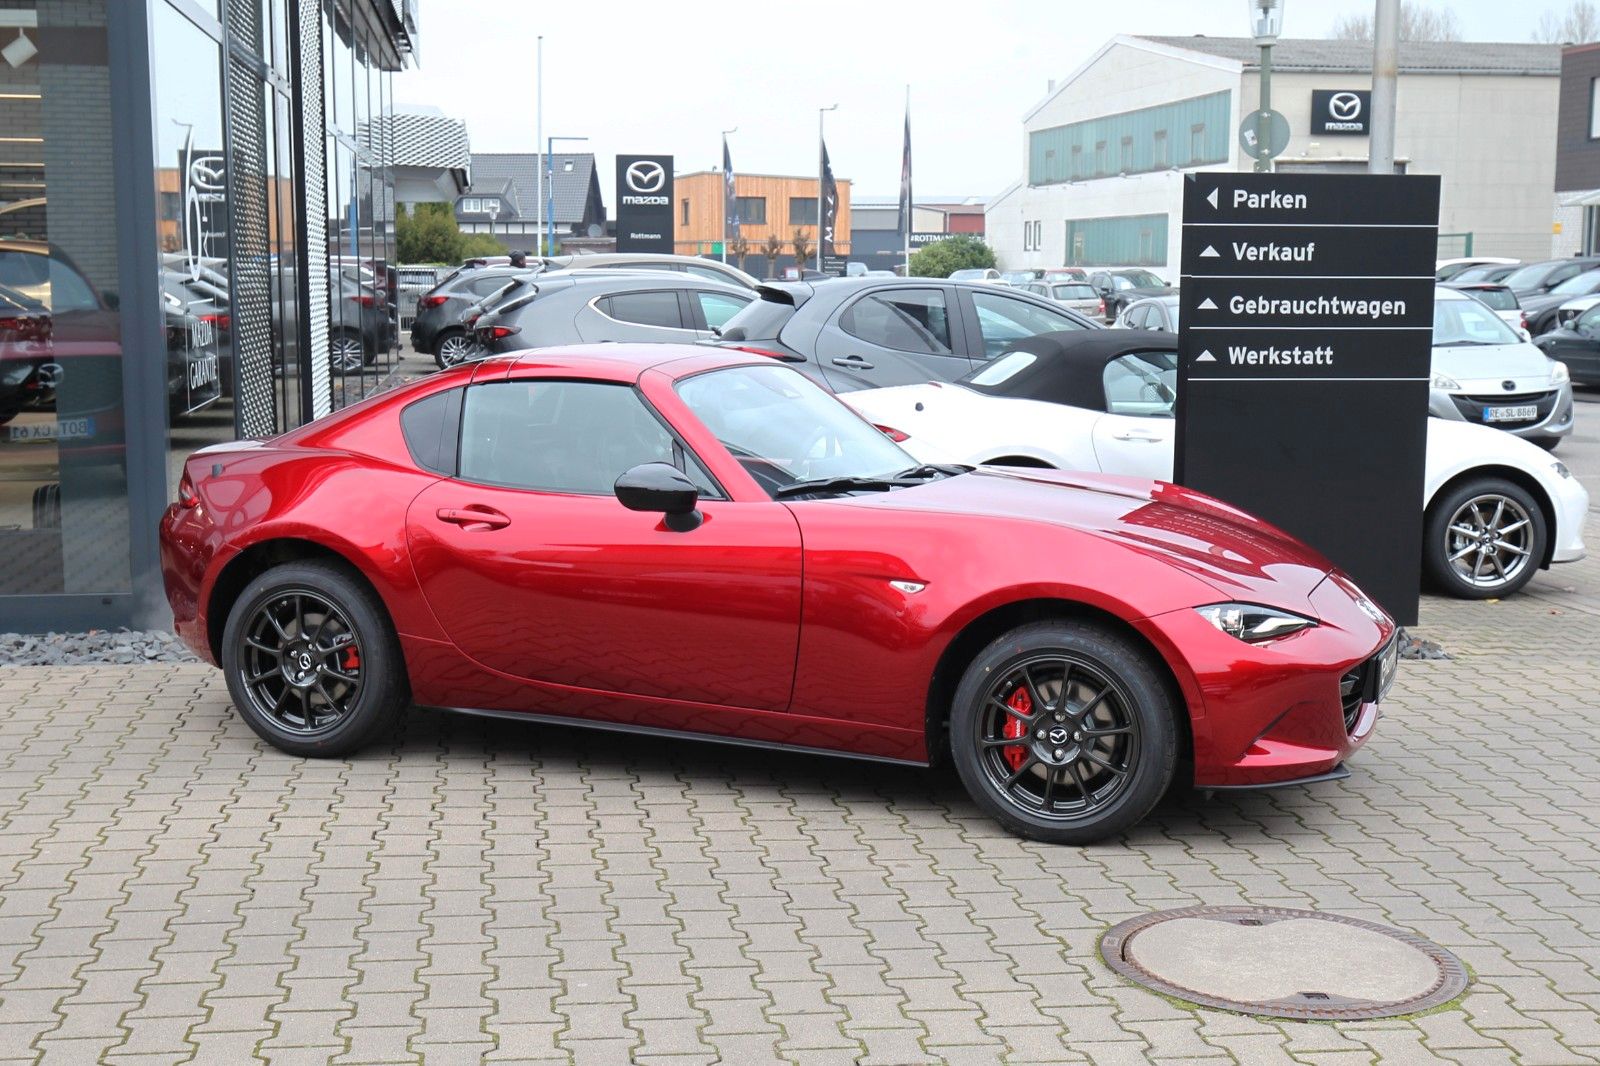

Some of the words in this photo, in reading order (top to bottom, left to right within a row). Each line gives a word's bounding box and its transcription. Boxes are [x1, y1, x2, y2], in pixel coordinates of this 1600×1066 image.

[1325, 122, 1363, 131] mazda
[622, 195, 669, 205] mazda
[1233, 189, 1307, 209] Parken
[1232, 242, 1315, 261] Verkauf
[1229, 295, 1406, 319] Gebrauchtwagen
[1228, 346, 1334, 365] Werkstatt
